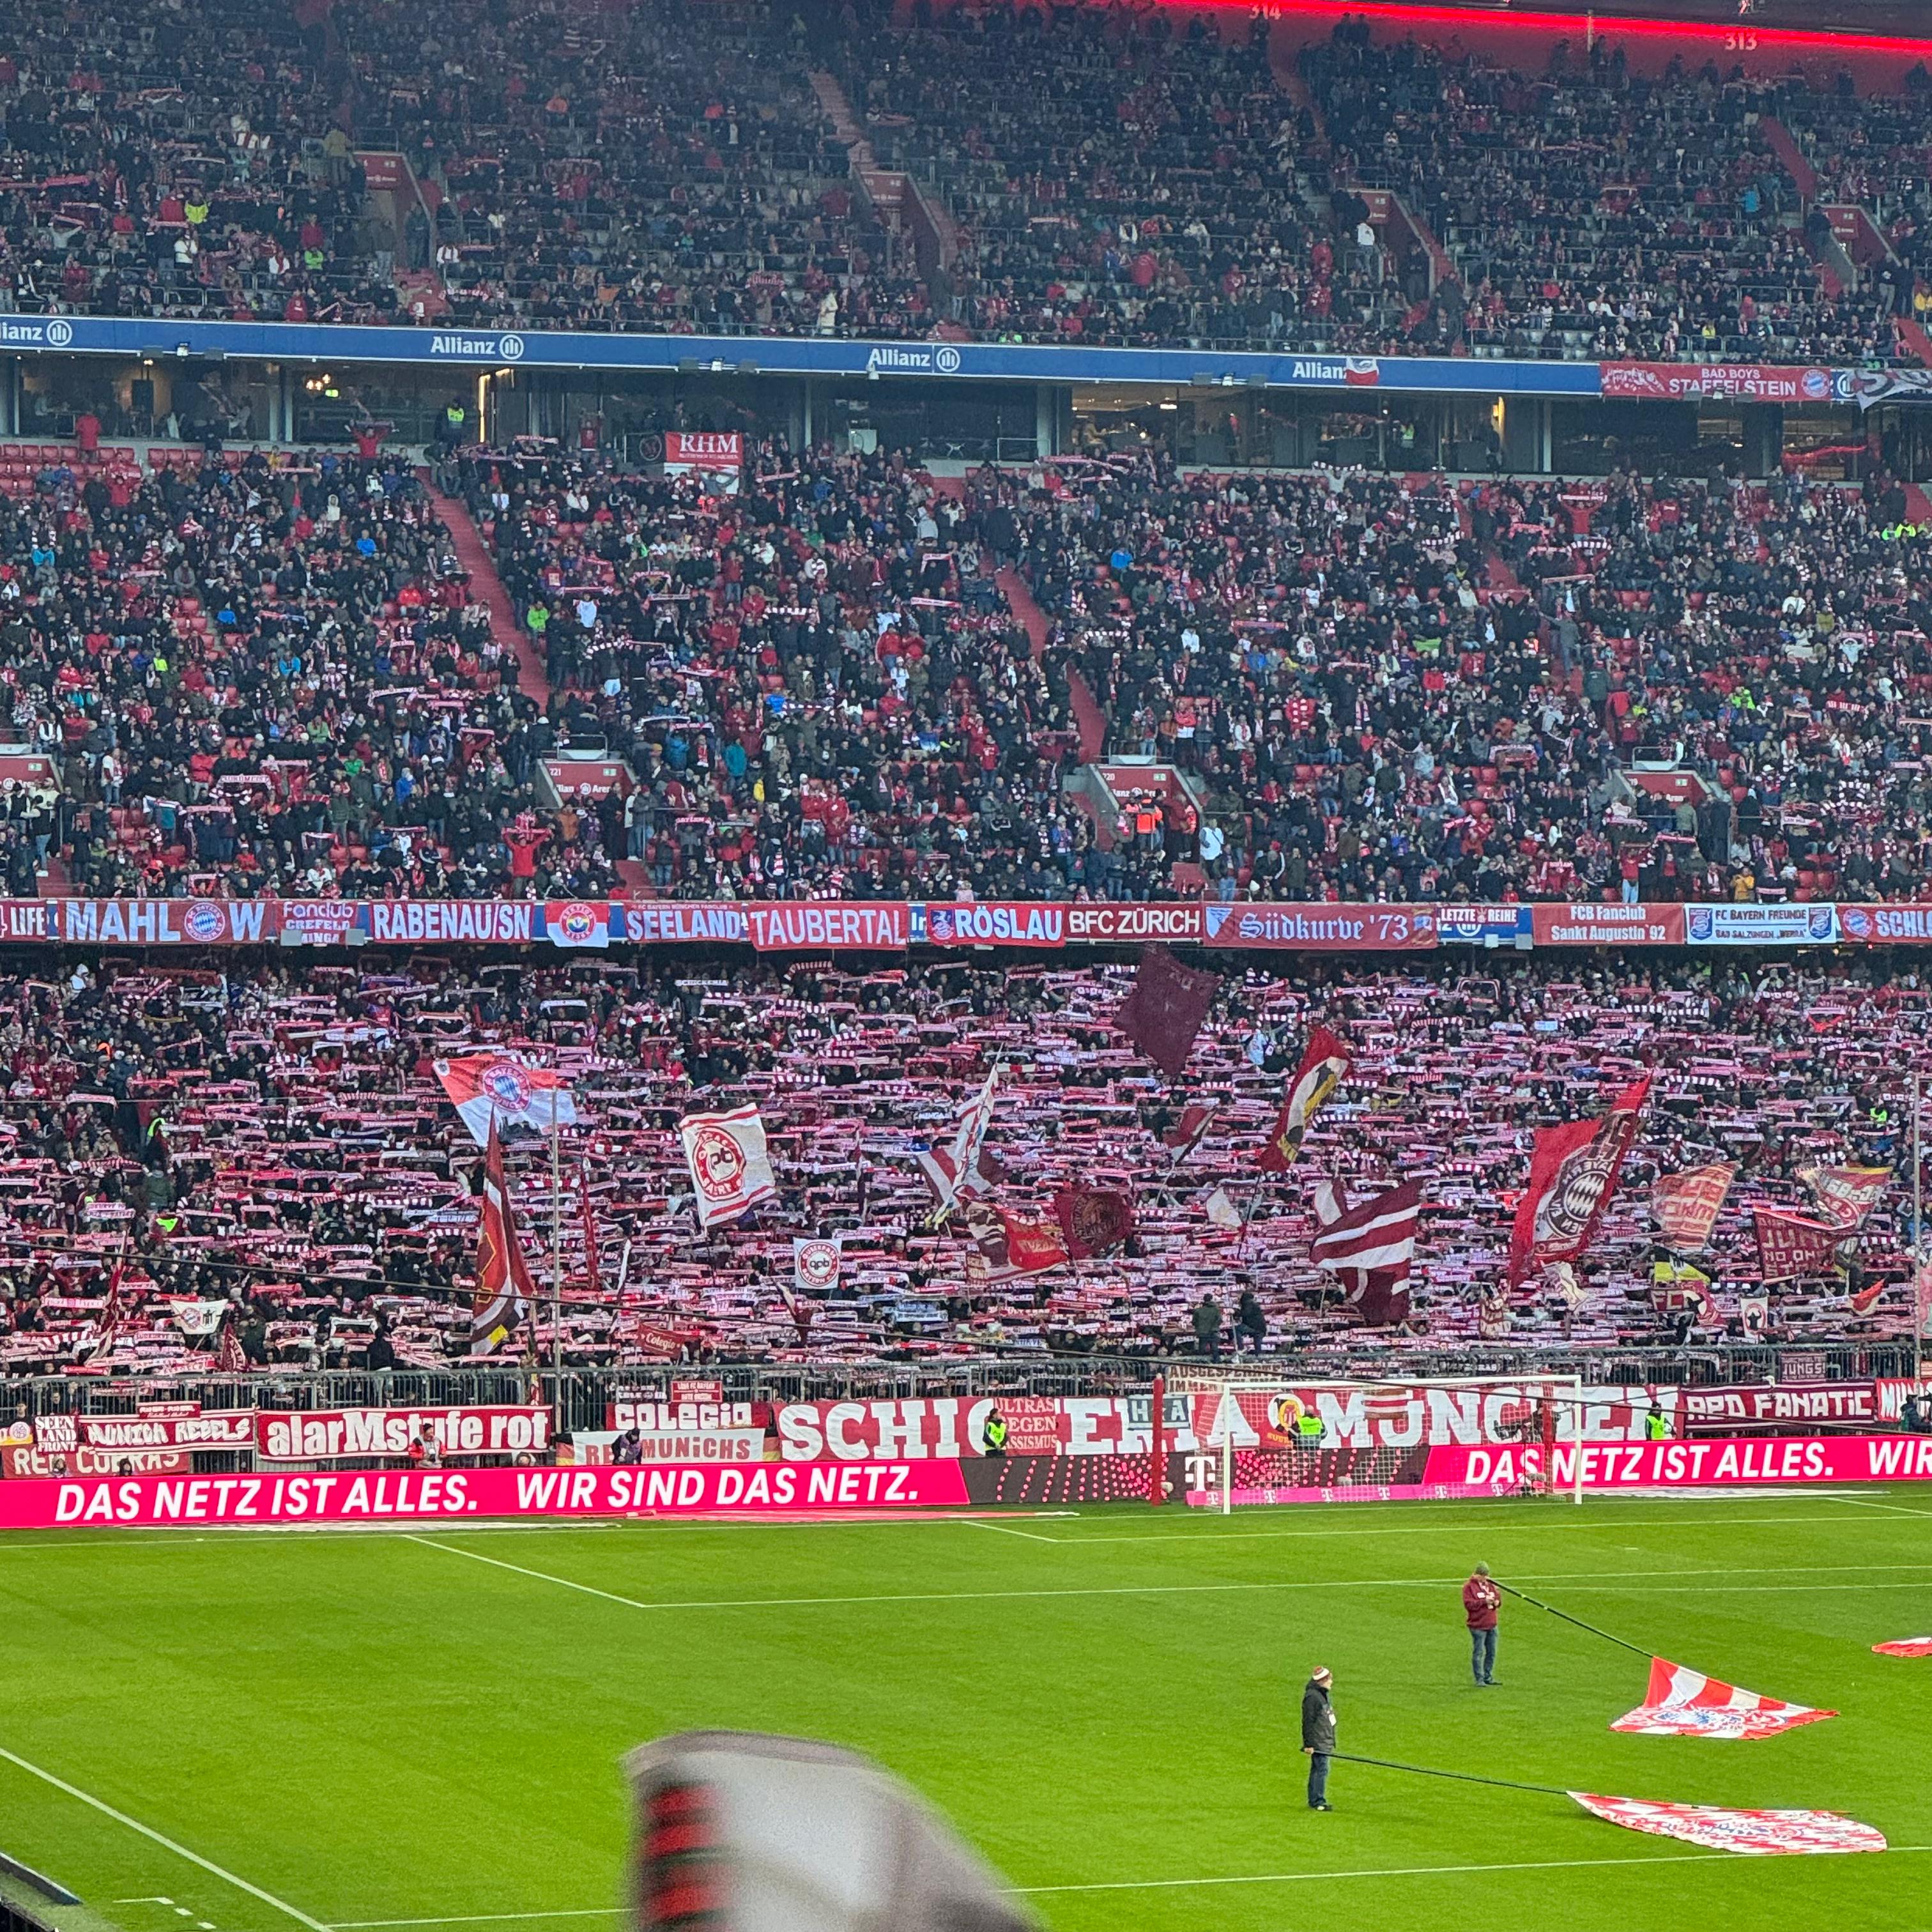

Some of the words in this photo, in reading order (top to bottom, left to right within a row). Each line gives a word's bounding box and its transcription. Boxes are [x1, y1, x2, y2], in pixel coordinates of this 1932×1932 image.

[1249, 3, 1281, 20] 314
[1725, 32, 1757, 50] 313
[431, 336, 495, 355] Allianz
[867, 348, 930, 367] Allianz
[1701, 368, 1726, 379] BAD
[1729, 369, 1761, 379] BOYS
[1669, 378, 1796, 396] STAFFELSTEIN
[680, 434, 739, 453] RHM
[283, 901, 354, 918] Fanclub
[1441, 908, 1476, 922] LETZTE
[1487, 908, 1517, 923] REIHE
[1570, 905, 1594, 921] FCB
[1597, 905, 1646, 921] Fanclub
[1715, 910, 1727, 920] FC
[1730, 909, 1765, 920] BAYERN
[1768, 909, 1806, 920] FREUNDE
[10, 907, 45, 936] LIFE
[65, 901, 181, 942] MAHL
[229, 902, 266, 942] W
[285, 919, 350, 931] CREFELD
[372, 903, 530, 940] RABENAU/SN
[627, 910, 740, 941] SEELAND
[749, 908, 907, 947] TAUBERTAL
[955, 905, 1062, 941] RÖSLAU
[1068, 910, 1114, 933] BFC
[1117, 907, 1201, 934] ZÜRICH
[1239, 911, 1364, 940] Südkurve
[1370, 914, 1409, 941] '73
[1551, 924, 1588, 941] Sankt
[1589, 925, 1646, 942] Augustin
[1715, 930, 1730, 939] BAD
[645, 1333, 675, 1351] Colegio
[1782, 1362, 1825, 1375] JUNGS!
[994, 1397, 1054, 1413] ULTRAS
[35, 1416, 75, 1429] SEEN
[175, 1418, 250, 1443] REBELS
[490, 1413, 549, 1450] rot
[35, 1429, 77, 1442] LAND
[38, 1441, 77, 1452] FRONT
[1465, 1448, 1542, 1484] DAS
[1552, 1446, 1645, 1483] NETZ
[1652, 1445, 1710, 1480] IST
[1713, 1441, 1834, 1478] ALLES.
[516, 1472, 597, 1508] WIR
[607, 1469, 706, 1507] SIND
[716, 1468, 797, 1505] DAS
[807, 1465, 919, 1503] NETZ.
[56, 1483, 141, 1522] DAS
[153, 1479, 261, 1519] NETZ
[271, 1478, 338, 1515] IST
[341, 1474, 478, 1514] ALLES.
